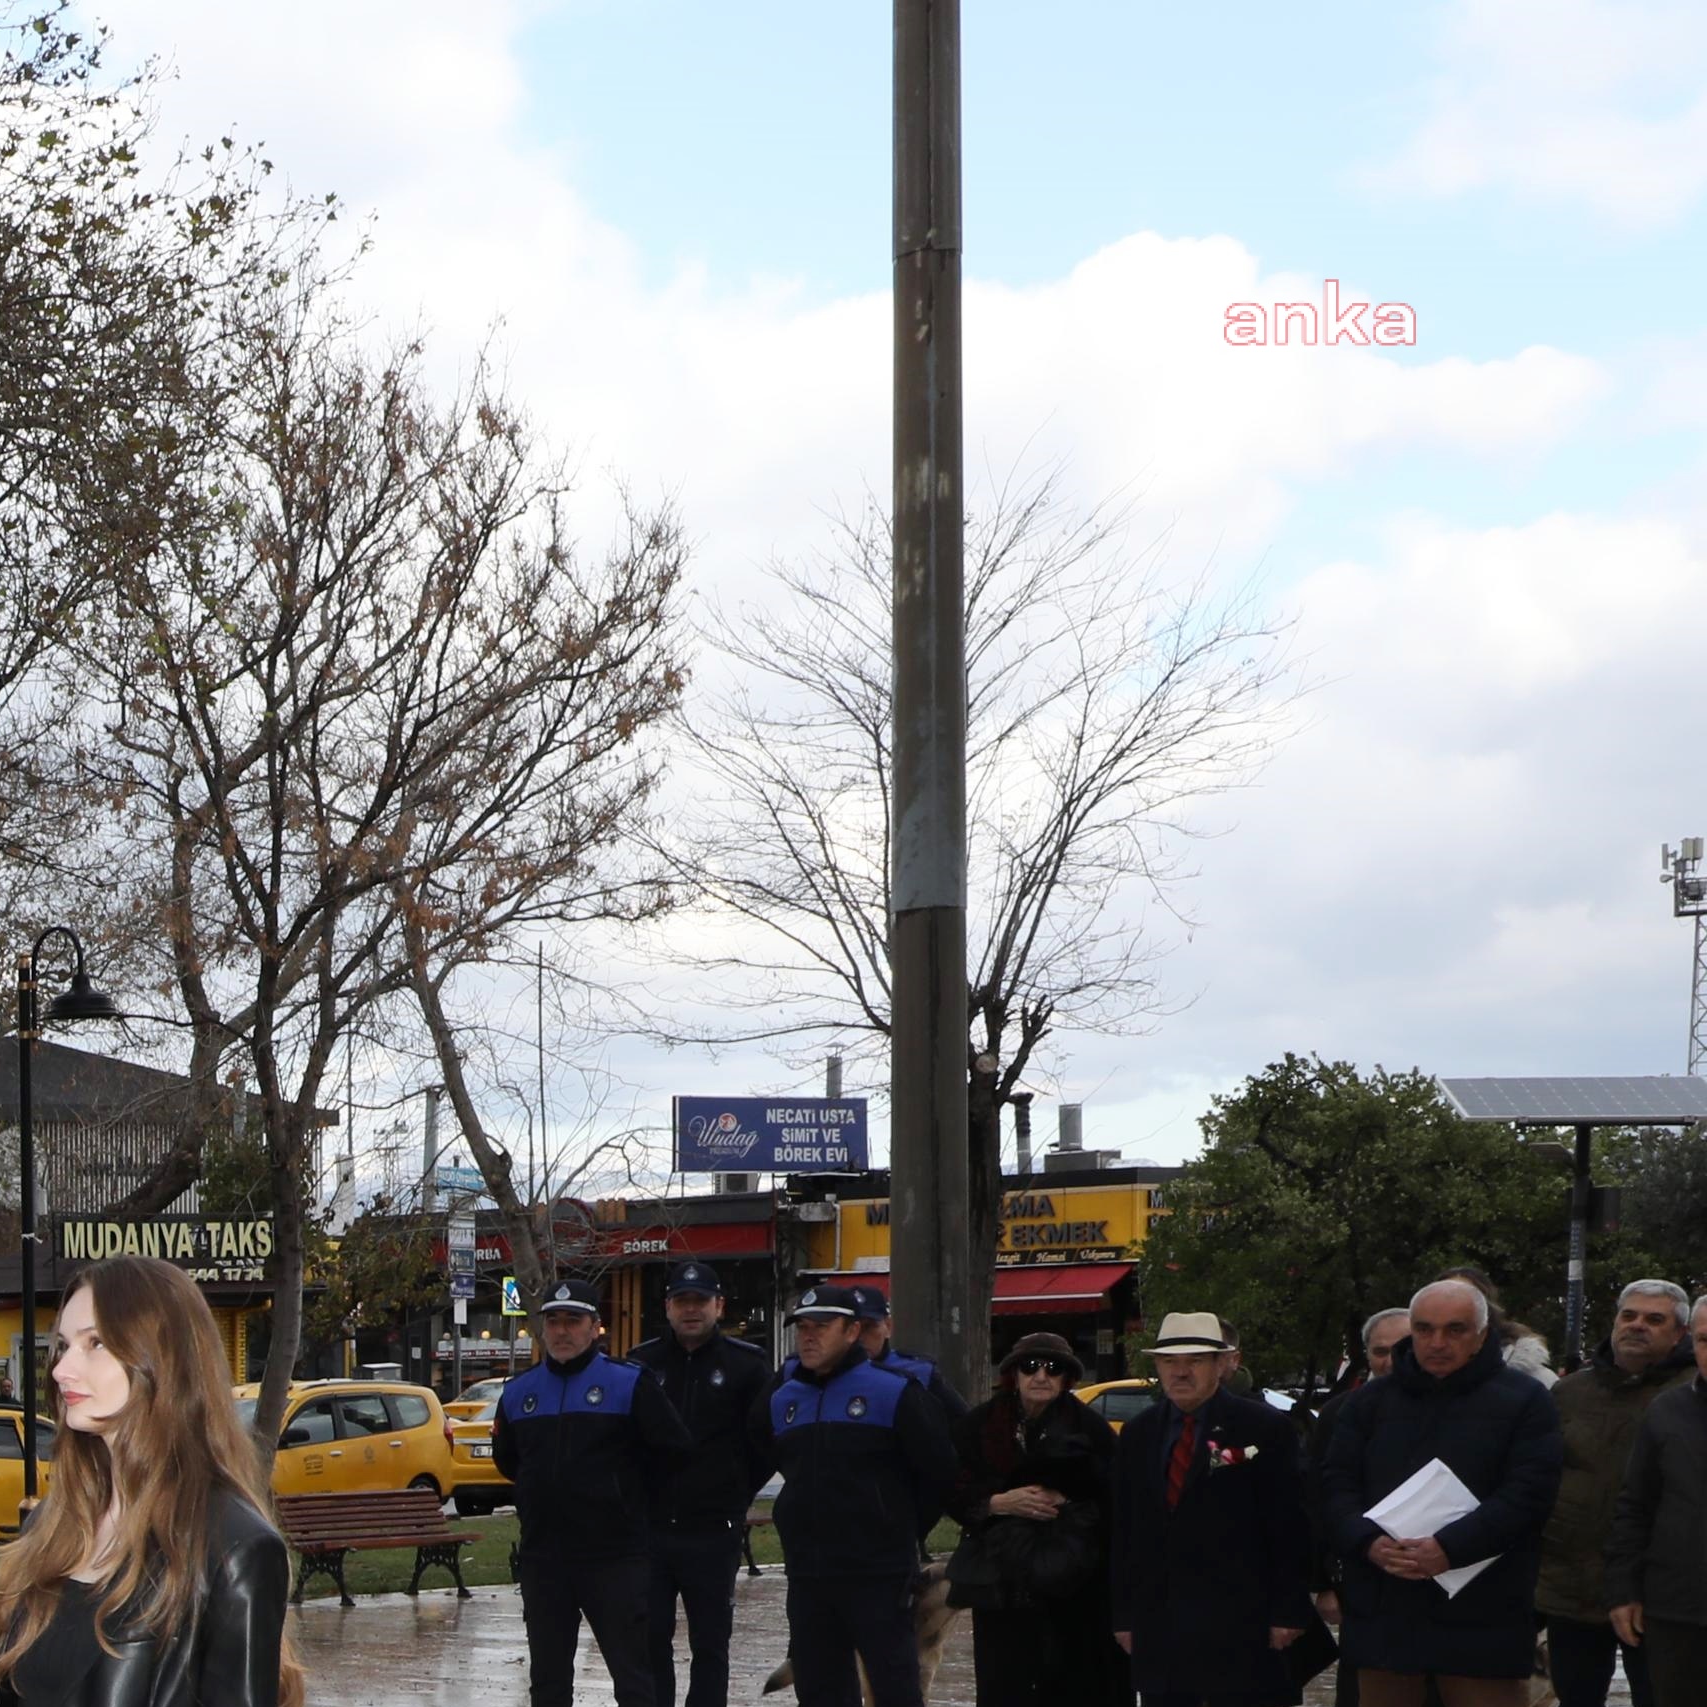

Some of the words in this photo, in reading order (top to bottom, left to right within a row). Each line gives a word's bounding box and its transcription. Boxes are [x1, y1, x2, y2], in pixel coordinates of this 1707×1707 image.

[766, 1109, 816, 1124] NECATİ
[820, 1109, 855, 1124] USTA
[688, 1115, 761, 1158] Uludağ
[781, 1128, 818, 1143] SİMİT
[822, 1129, 841, 1143] VE
[774, 1145, 822, 1162] BÖREK
[826, 1147, 848, 1162] EVİ
[64, 1221, 194, 1259] MUDANYA
[206, 1220, 274, 1258] TAKS
[1011, 1220, 1108, 1247] EKMEK
[623, 1239, 668, 1254] BÖREK
